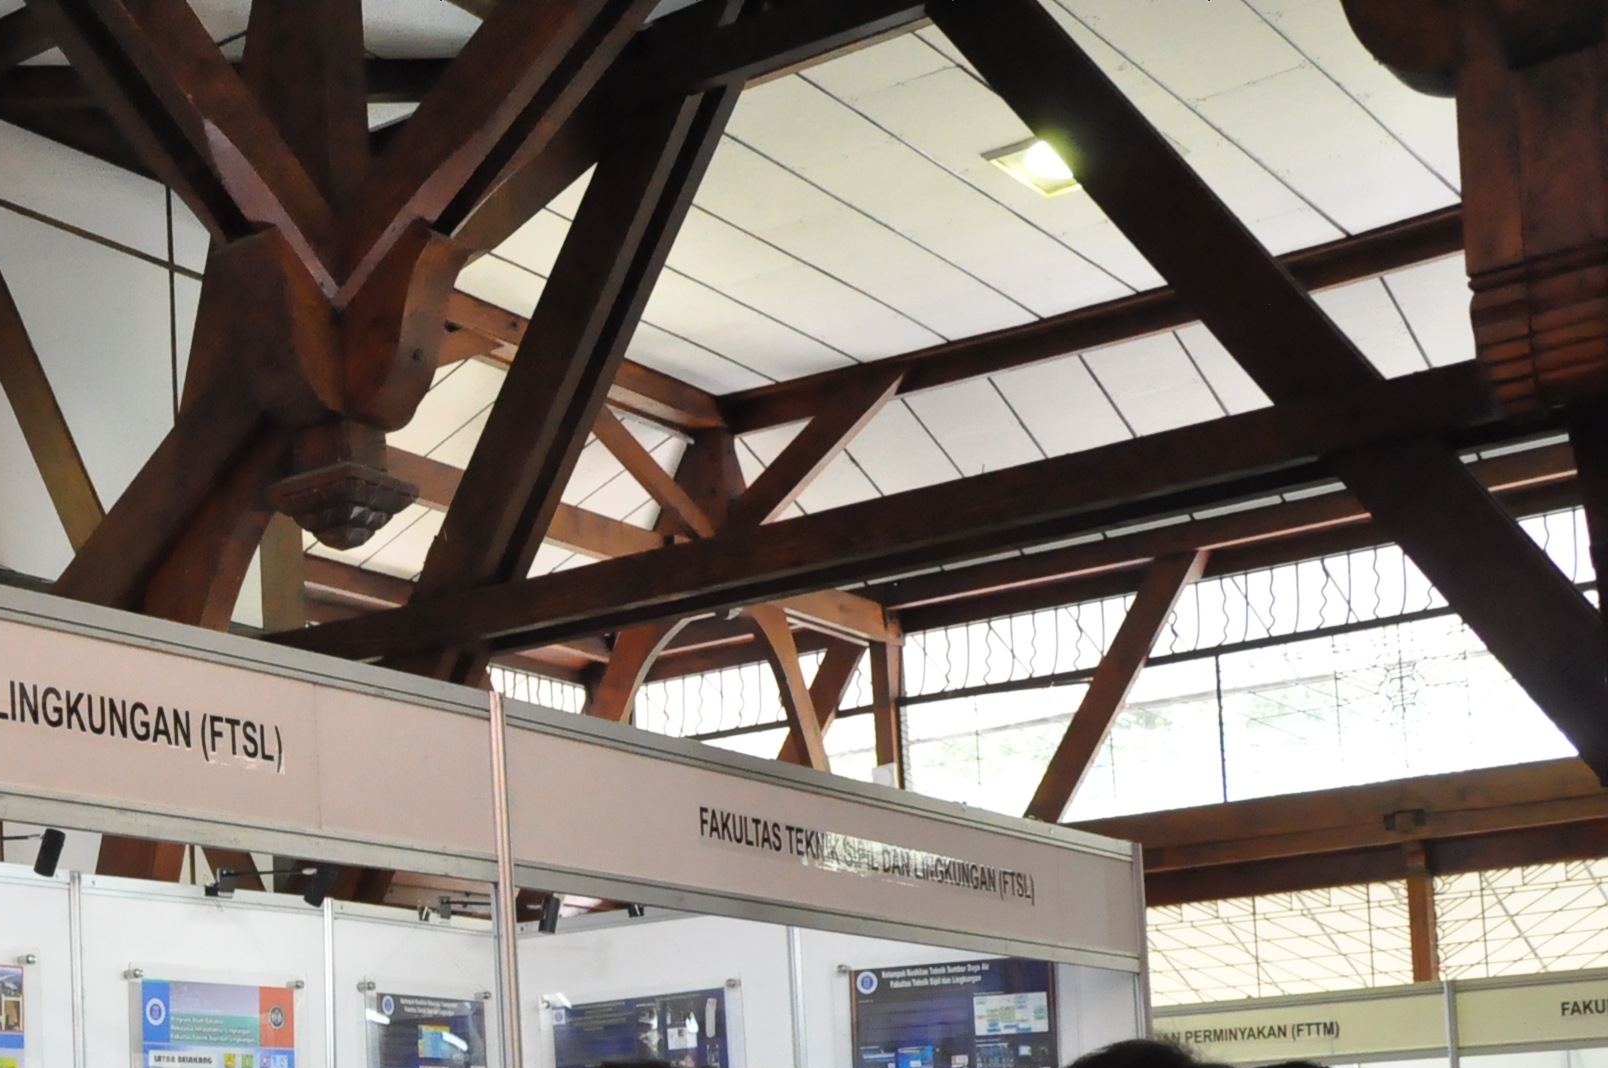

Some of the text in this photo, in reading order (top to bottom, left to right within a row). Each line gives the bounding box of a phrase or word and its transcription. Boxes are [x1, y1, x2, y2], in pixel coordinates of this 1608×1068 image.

[201, 714, 284, 774] (FTSL)
[699, 806, 1035, 905] FAKULTAS TEKNIK SIPIL DAN LINGKUNGAN (FTSL)
[1561, 999, 1608, 1016] FAKU
[1185, 1025, 1287, 1044] PERMINYAKAN
[1291, 1021, 1340, 1041] (FTTM)
